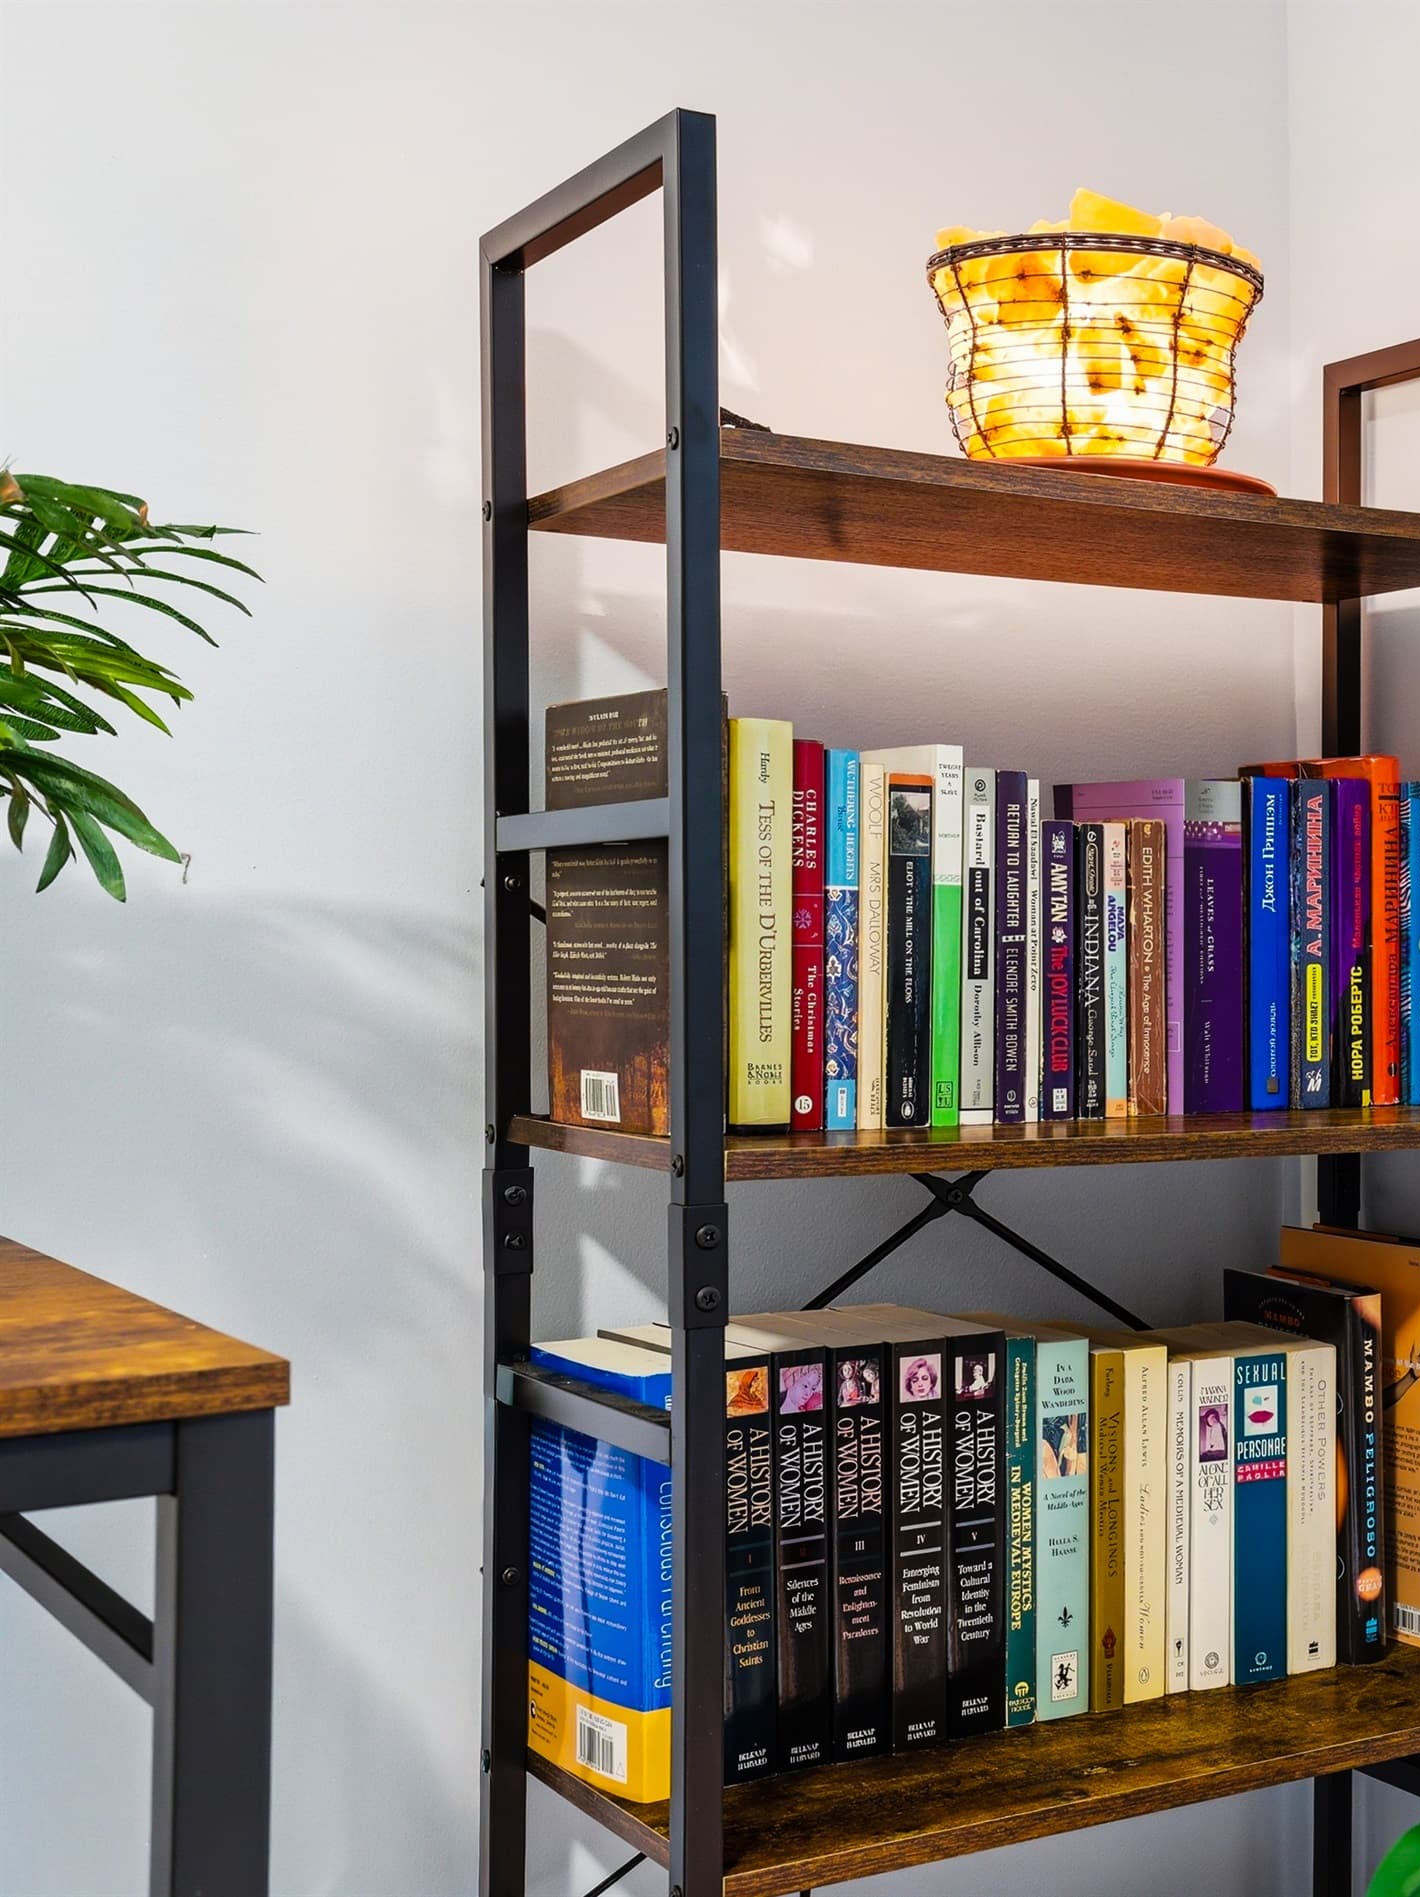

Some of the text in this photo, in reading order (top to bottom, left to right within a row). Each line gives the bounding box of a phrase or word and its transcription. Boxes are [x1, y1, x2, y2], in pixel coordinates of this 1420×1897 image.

[758, 752, 770, 784] Hardy
[845, 759, 857, 881] WUTHERING HEIGHTS
[868, 777, 883, 840] WOOLF
[793, 790, 804, 868] DICKENS
[805, 789, 817, 869] CHARLES
[974, 813, 986, 866] Bastard
[1006, 803, 1020, 928] RETURN TO LAUGHTER
[1262, 794, 1277, 913] Джон Гришэм
[758, 871, 772, 908] THE
[974, 869, 985, 893] out
[1306, 794, 1323, 957] А. МАРИНИНА
[974, 897, 985, 914] of
[1050, 862, 1068, 922] AMY TAN
[1142, 847, 1154, 963] EDITH WHARTON
[868, 862, 881, 976] MRS DALLOWAY
[904, 861, 914, 1004] ELIOT THE MILL ON THE FLOSS
[1107, 895, 1117, 953] ANGELOU
[1117, 905, 1125, 940] MAYA
[973, 916, 985, 976] Carolina
[1084, 914, 1099, 1008] INDIANA
[793, 988, 804, 1031] Stories
[807, 964, 817, 1054] The Christmas
[972, 984, 983, 1028] Dorothy
[1005, 948, 1019, 1072] ELENORE SMITH BOWEN
[1048, 945, 1069, 1073] The JOY LUCK CLUB
[1086, 1009, 1098, 1049] George
[1141, 974, 1152, 1074] The Age of Innocence
[1350, 966, 1363, 1080] НОРА РОБЕРТС
[973, 1031, 983, 1066] Allison
[1087, 1050, 1098, 1076] Sand
[1053, 1375, 1074, 1385] DARK
[1237, 1362, 1286, 1385] SEXUAL
[1041, 1399, 1085, 1409] WANDERING
[1053, 1387, 1076, 1396] WOOD
[1141, 1366, 1150, 1468] ALFRED ALLAN LEWIS
[1237, 1436, 1286, 1460] PERSONAE
[1317, 1379, 1327, 1501] OTHER POWERS
[1363, 1339, 1376, 1558] MAMBO PELIGROSO
[803, 1423, 824, 1523] A HISTORY
[837, 1417, 858, 1519] OF WOMEN
[860, 1416, 882, 1514] A HISTORY
[900, 1412, 920, 1513] OF WOMEN
[922, 1411, 943, 1509] A HISTORY
[955, 1411, 974, 1510] OF WOMEN
[976, 1410, 996, 1505] A HISTORY
[1199, 1462, 1229, 1476] ALONE
[1237, 1461, 1286, 1473] CAMILLE
[727, 1429, 748, 1534] OF WOMEN
[750, 1428, 771, 1527] A HISTORY
[780, 1425, 801, 1528] OF WOMEN
[1198, 1474, 1228, 1488] OF ALL
[1237, 1470, 1286, 1482] PAGLIA
[1043, 1487, 1086, 1501] A Novel of the
[1107, 1411, 1120, 1577] VISIONS and LONGINGS
[1175, 1411, 1184, 1585] MEMOIRS OF A MEDIEVAL WOMAN
[1203, 1486, 1224, 1499] HER
[1203, 1499, 1224, 1512] SEX
[855, 1540, 865, 1551] III
[916, 1534, 926, 1545] IV
[1010, 1465, 1021, 1631] IN MEDIEVAL EUROPE
[1021, 1481, 1032, 1612] WOMEN MYSTICS
[838, 1572, 882, 1585] Renaissance
[902, 1565, 940, 1579] Emerging
[957, 1560, 993, 1574] Toward a
[959, 1573, 991, 1587] Cultural
[738, 1585, 761, 1597] From
[786, 1578, 819, 1591] Silences
[791, 1591, 815, 1604] of the
[853, 1586, 867, 1597] and
[902, 1578, 940, 1593] Feminism
[911, 1593, 931, 1604] from
[961, 1588, 990, 1601] Identity
[730, 1611, 771, 1627] Goddesses
[736, 1598, 765, 1611] Ancient
[790, 1604, 817, 1619] Middle
[851, 1614, 870, 1625] ment
[900, 1605, 942, 1620] Revolution
[957, 1613, 994, 1628] Twentieth
[964, 1602, 987, 1614] in the
[746, 1629, 755, 1638] to
[794, 1621, 813, 1633] Ages
[841, 1627, 880, 1641] Paradoxes
[904, 1618, 939, 1633] to World
[912, 1634, 930, 1645] War
[960, 1628, 991, 1642] Century
[732, 1640, 769, 1655] Christian
[739, 1655, 763, 1668] Saints
